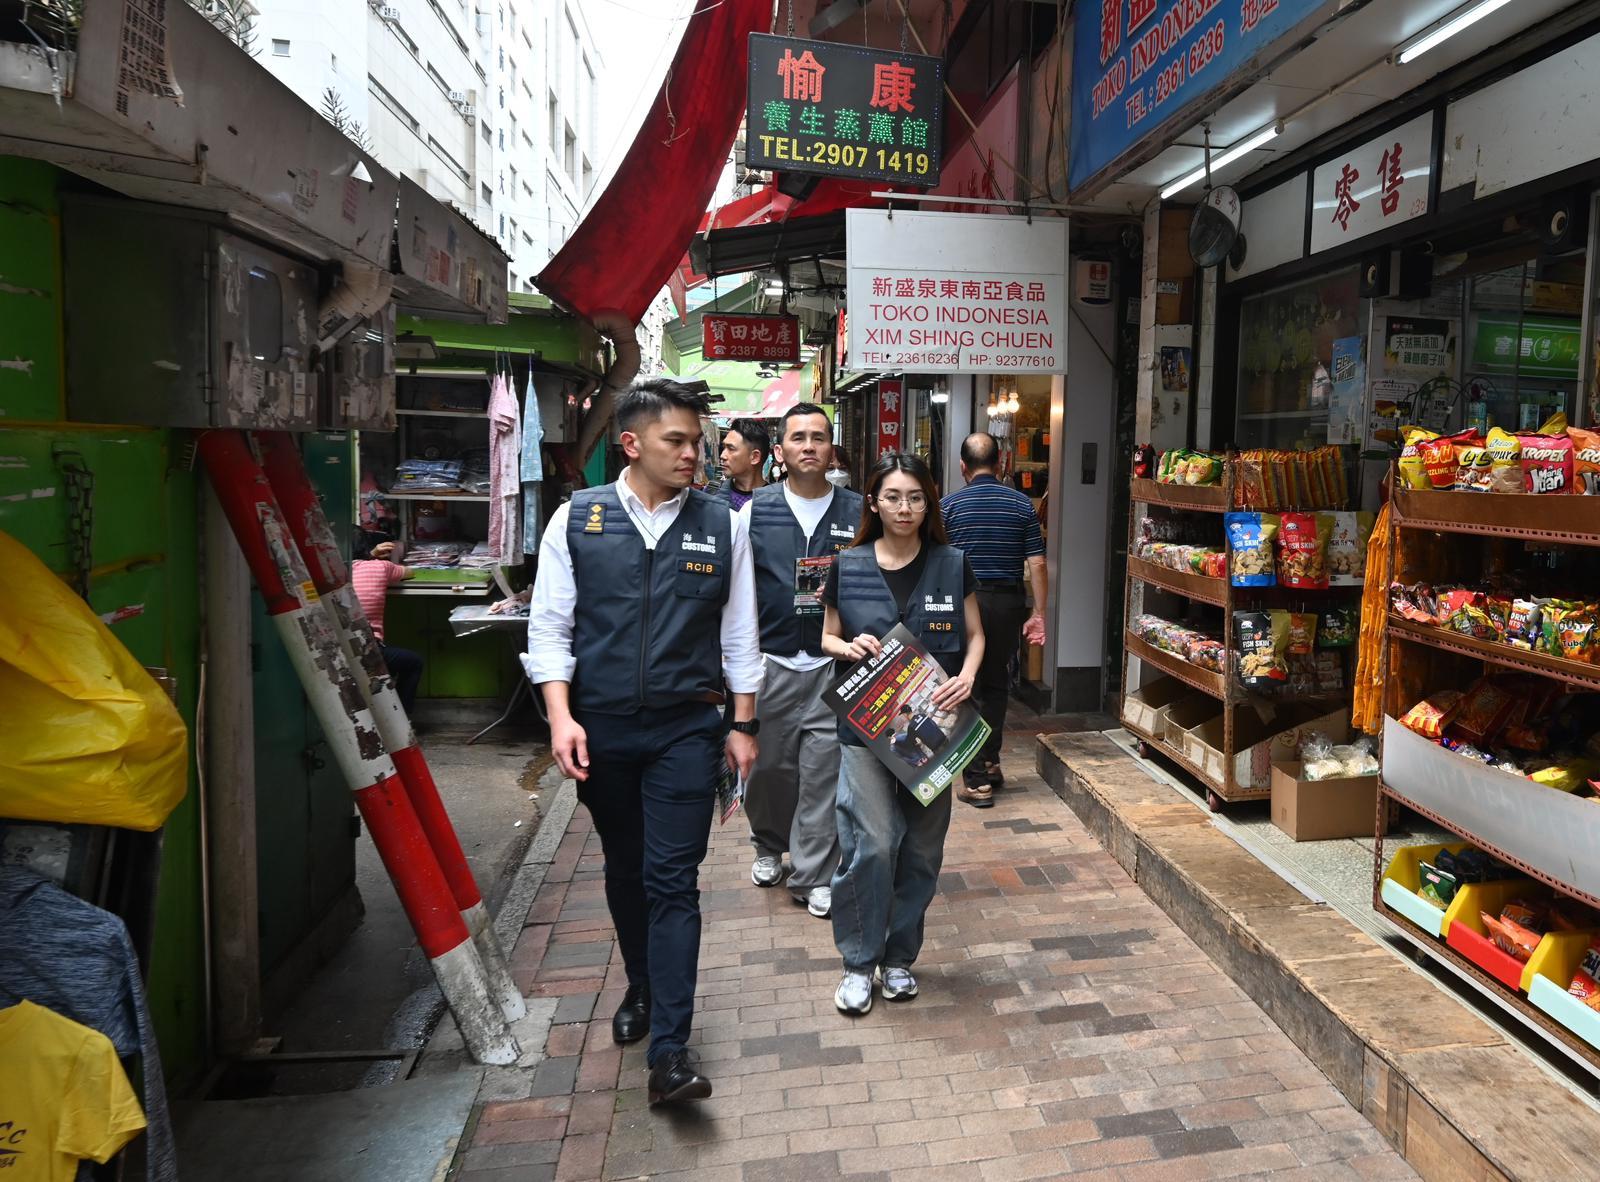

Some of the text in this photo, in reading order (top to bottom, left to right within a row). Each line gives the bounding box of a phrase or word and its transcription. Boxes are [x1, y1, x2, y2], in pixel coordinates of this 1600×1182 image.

[1156, 54, 1185, 103] 2361
[1189, 19, 1224, 77] 6236
[1092, 57, 1126, 119] TOKO
[759, 135, 930, 175] TEL:2907 1419
[872, 276, 1046, 302] 新盛泉東南亞食品
[869, 304, 1049, 325] TOKO INDONESIA
[710, 319, 793, 345] 寶田地產
[865, 328, 1053, 349] XIM SHING CHUEN
[730, 346, 790, 357] 2387 9899
[896, 352, 959, 365] 23616236
[969, 354, 991, 366] HP:
[995, 355, 1055, 367] 92377610
[1521, 446, 1568, 463] KROPEK
[681, 541, 716, 554] CUSTOMS
[686, 562, 713, 573] RCIB
[924, 603, 954, 611] CUSTOMS
[929, 622, 951, 631] RCIB
[1242, 640, 1254, 648] FISH
